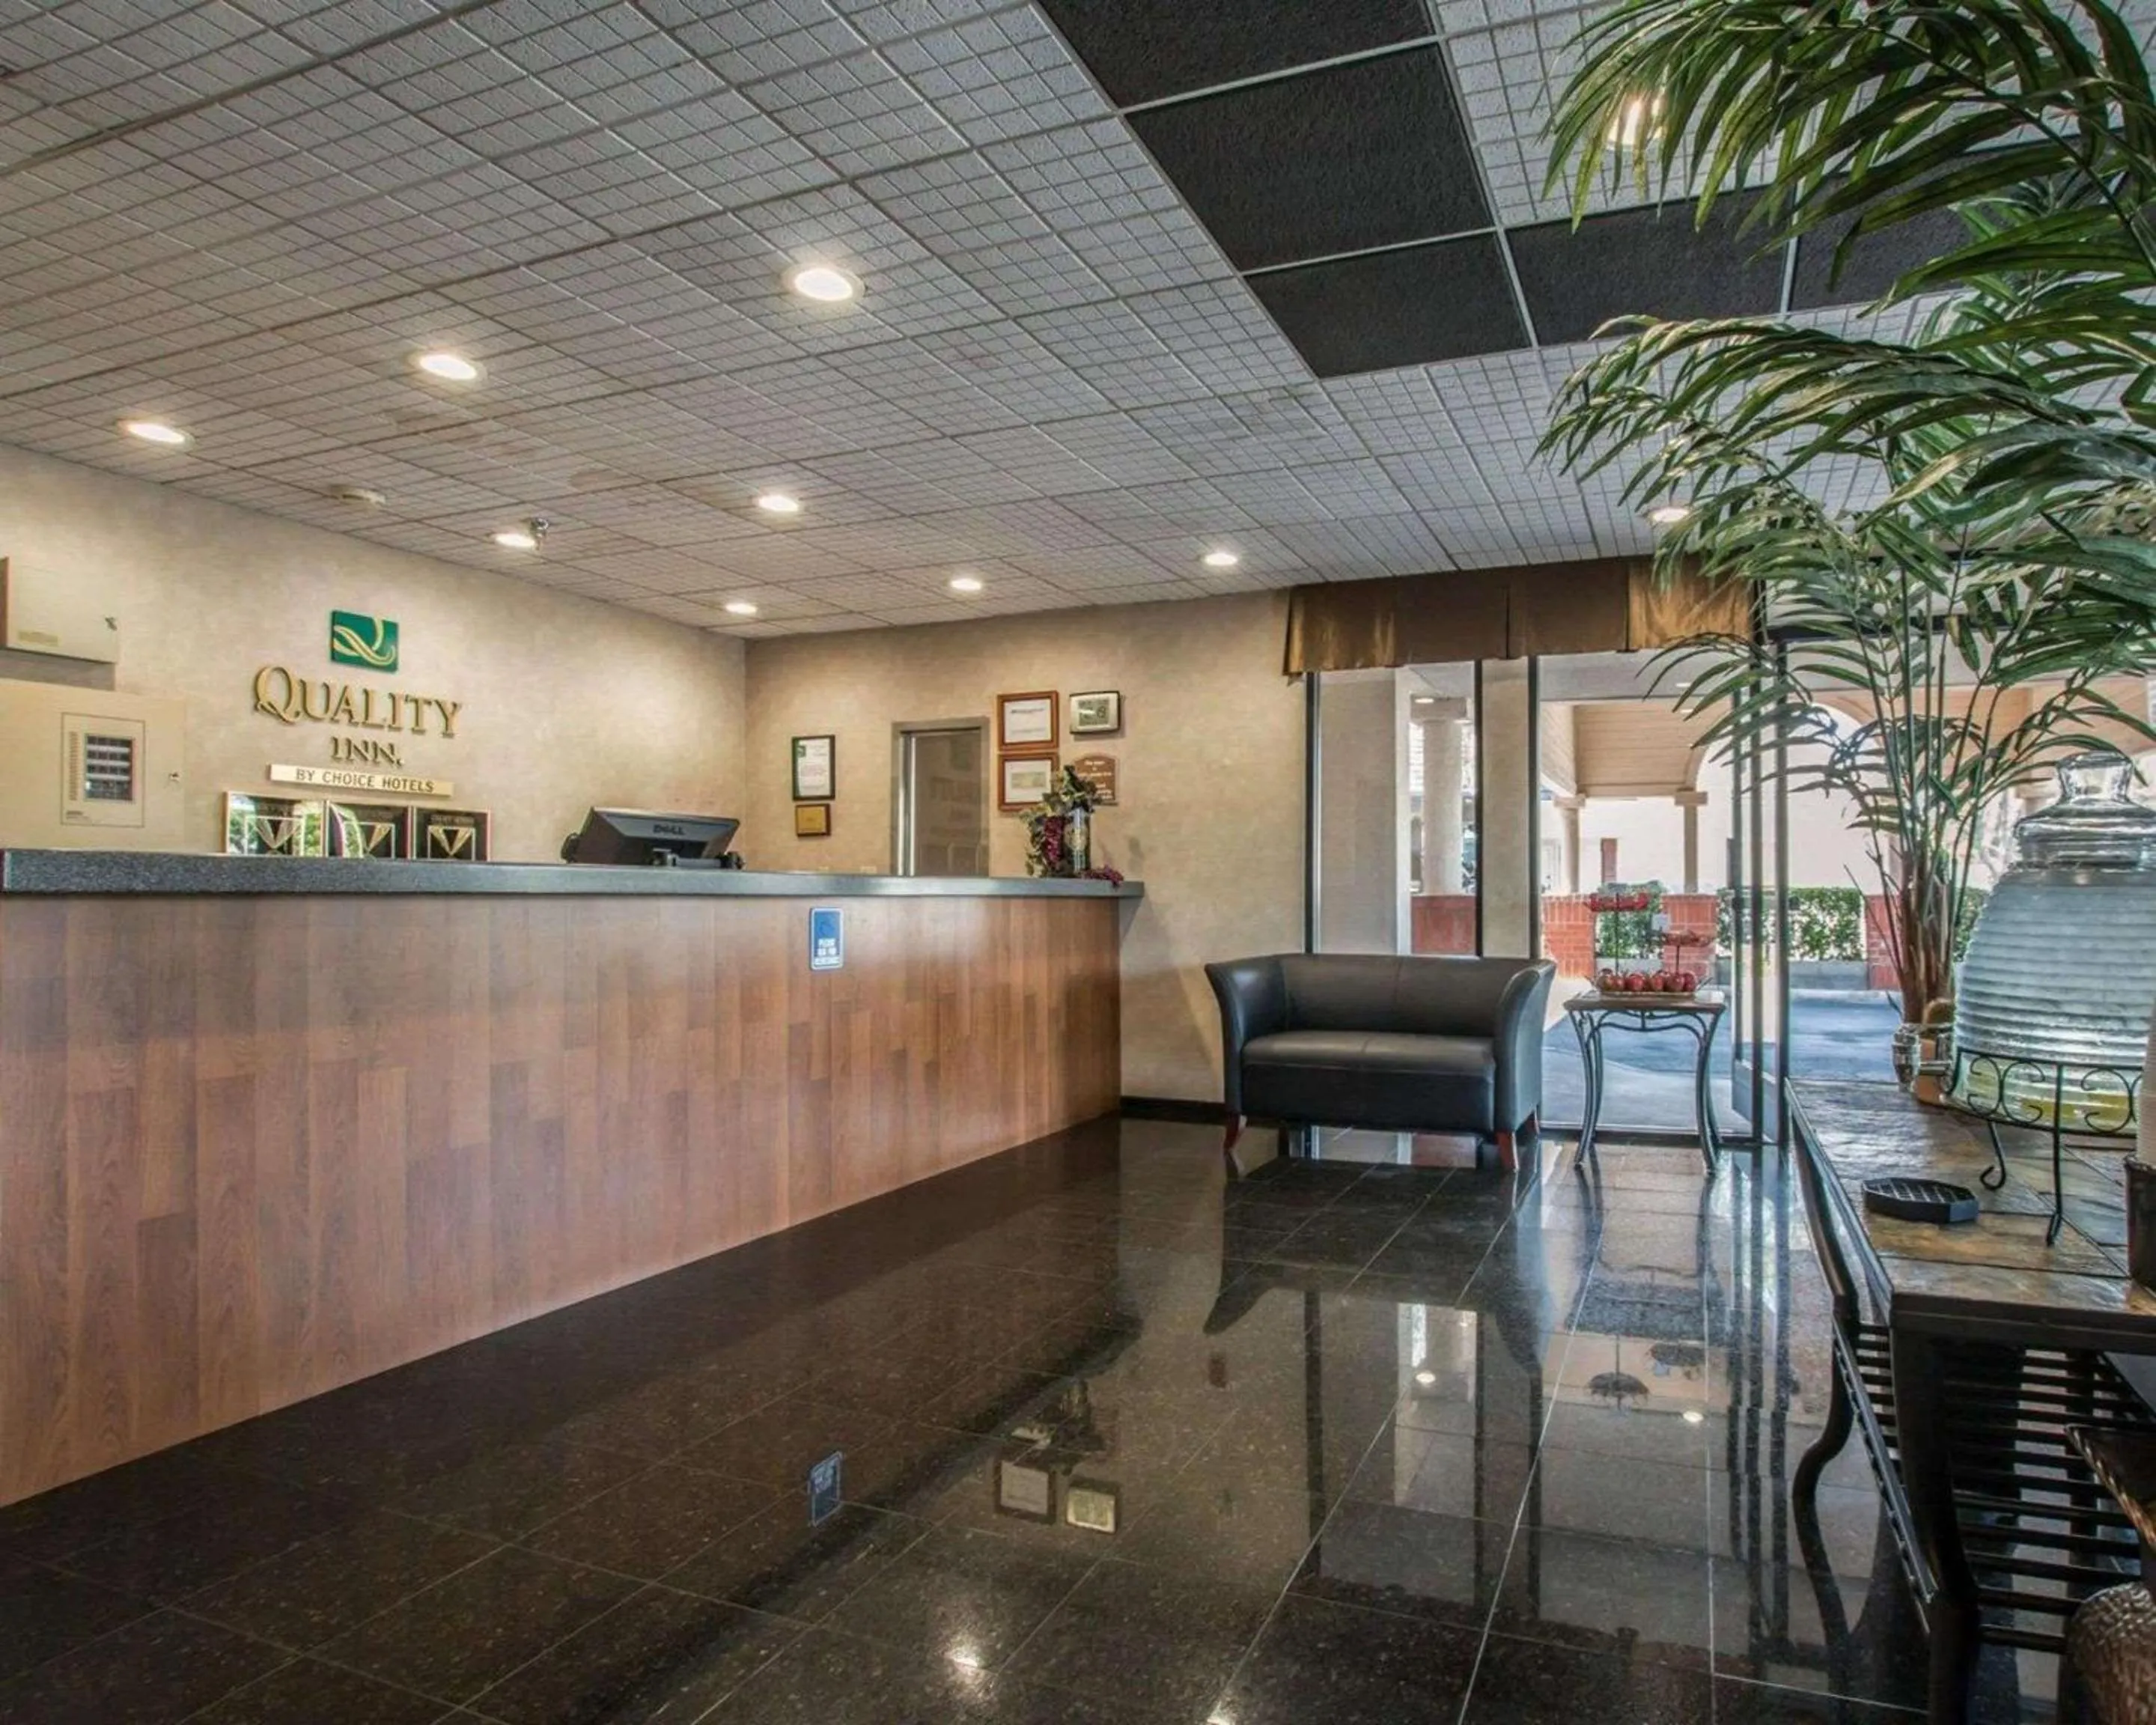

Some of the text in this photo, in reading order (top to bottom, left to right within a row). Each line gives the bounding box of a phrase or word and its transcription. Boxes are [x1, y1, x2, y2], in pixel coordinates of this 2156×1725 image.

[254, 666, 462, 737] QUALITY
[296, 767, 434, 794] BY CHOICE HOTELS
[653, 824, 686, 836] DELL
